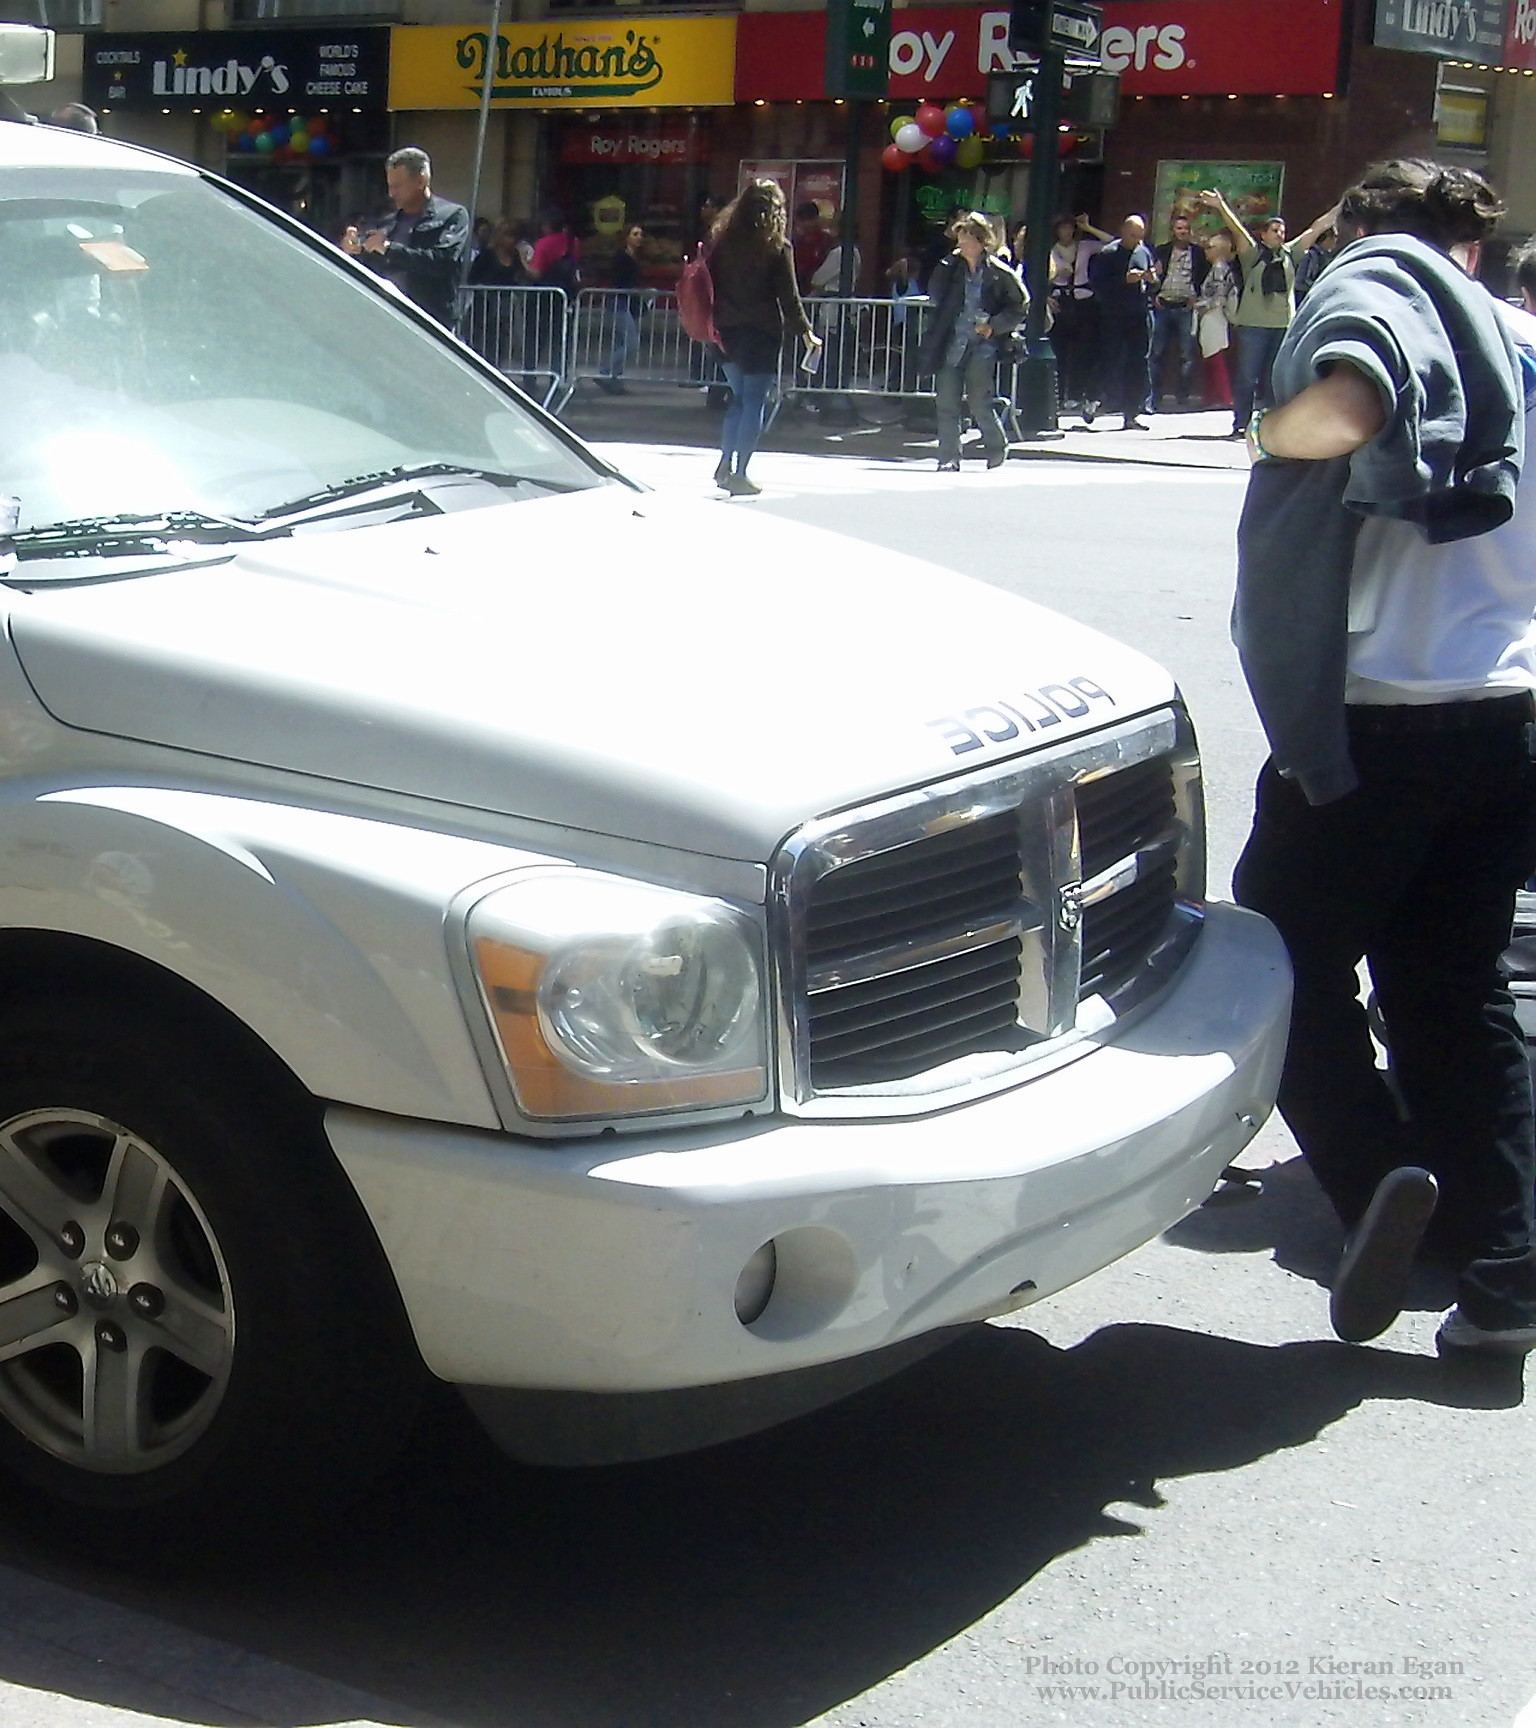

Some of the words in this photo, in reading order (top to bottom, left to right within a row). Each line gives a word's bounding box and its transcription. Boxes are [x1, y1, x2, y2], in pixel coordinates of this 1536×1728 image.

[456, 30, 657, 80] Nathan's
[888, 30, 955, 82] oy
[978, 12, 1186, 74] Rers
[153, 55, 290, 95] Lindy's
[591, 135, 622, 157] Roy
[628, 135, 686, 159] Rogers
